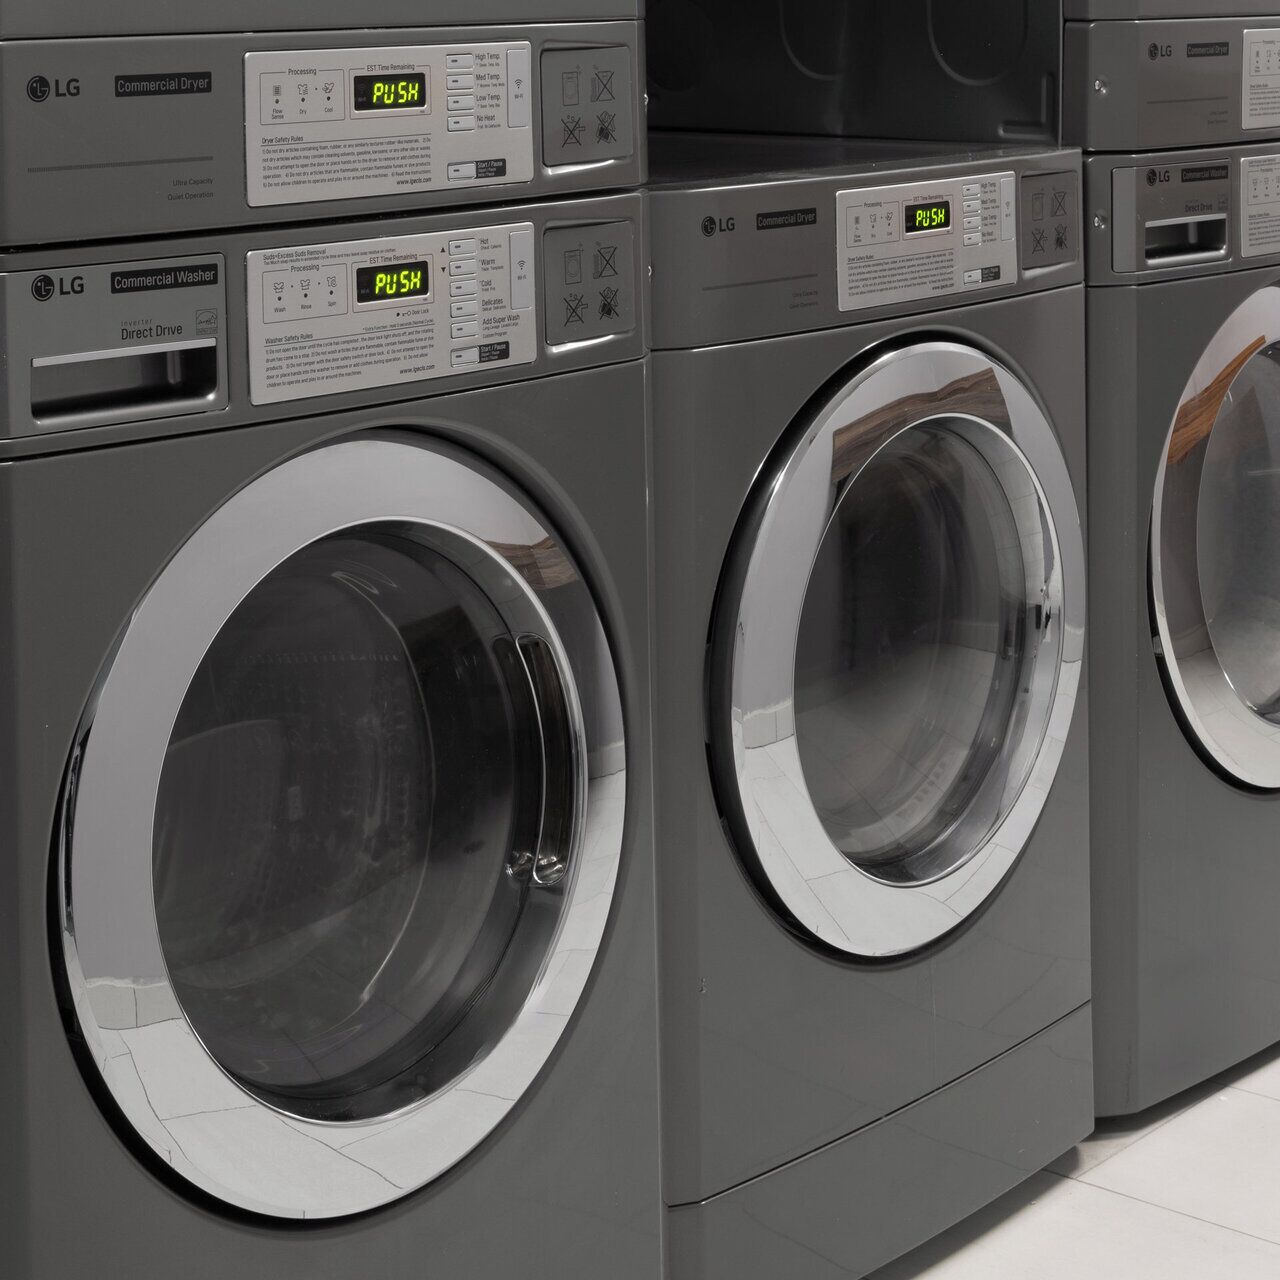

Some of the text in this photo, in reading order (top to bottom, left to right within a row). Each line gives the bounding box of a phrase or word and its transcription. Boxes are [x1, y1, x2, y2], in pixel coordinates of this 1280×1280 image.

[1160, 46, 1171, 56] LG
[1214, 44, 1228, 55] Dryer
[288, 67, 316, 76] Processing
[390, 63, 414, 71] Remaining
[55, 78, 79, 97] LG
[117, 77, 208, 92] Commercial Dryer
[373, 81, 418, 104] PUSH
[274, 136, 290, 144] Safety
[290, 135, 304, 143] Rules
[188, 177, 212, 185] Capacity
[1158, 171, 1169, 182] LG
[184, 191, 213, 200] Operation
[758, 211, 816, 226] Commercial Dryer
[916, 209, 944, 227] PUSH
[719, 217, 734, 232] LG
[392, 253, 417, 262] Remaining
[290, 264, 319, 272] Processing
[114, 269, 214, 288] Commercial Washer
[375, 271, 420, 294] PUSH
[59, 276, 83, 295] LG
[121, 326, 152, 340] Direct
[156, 323, 182, 336] Drive
[283, 334, 299, 343] Safety
[300, 333, 314, 341] Rules
